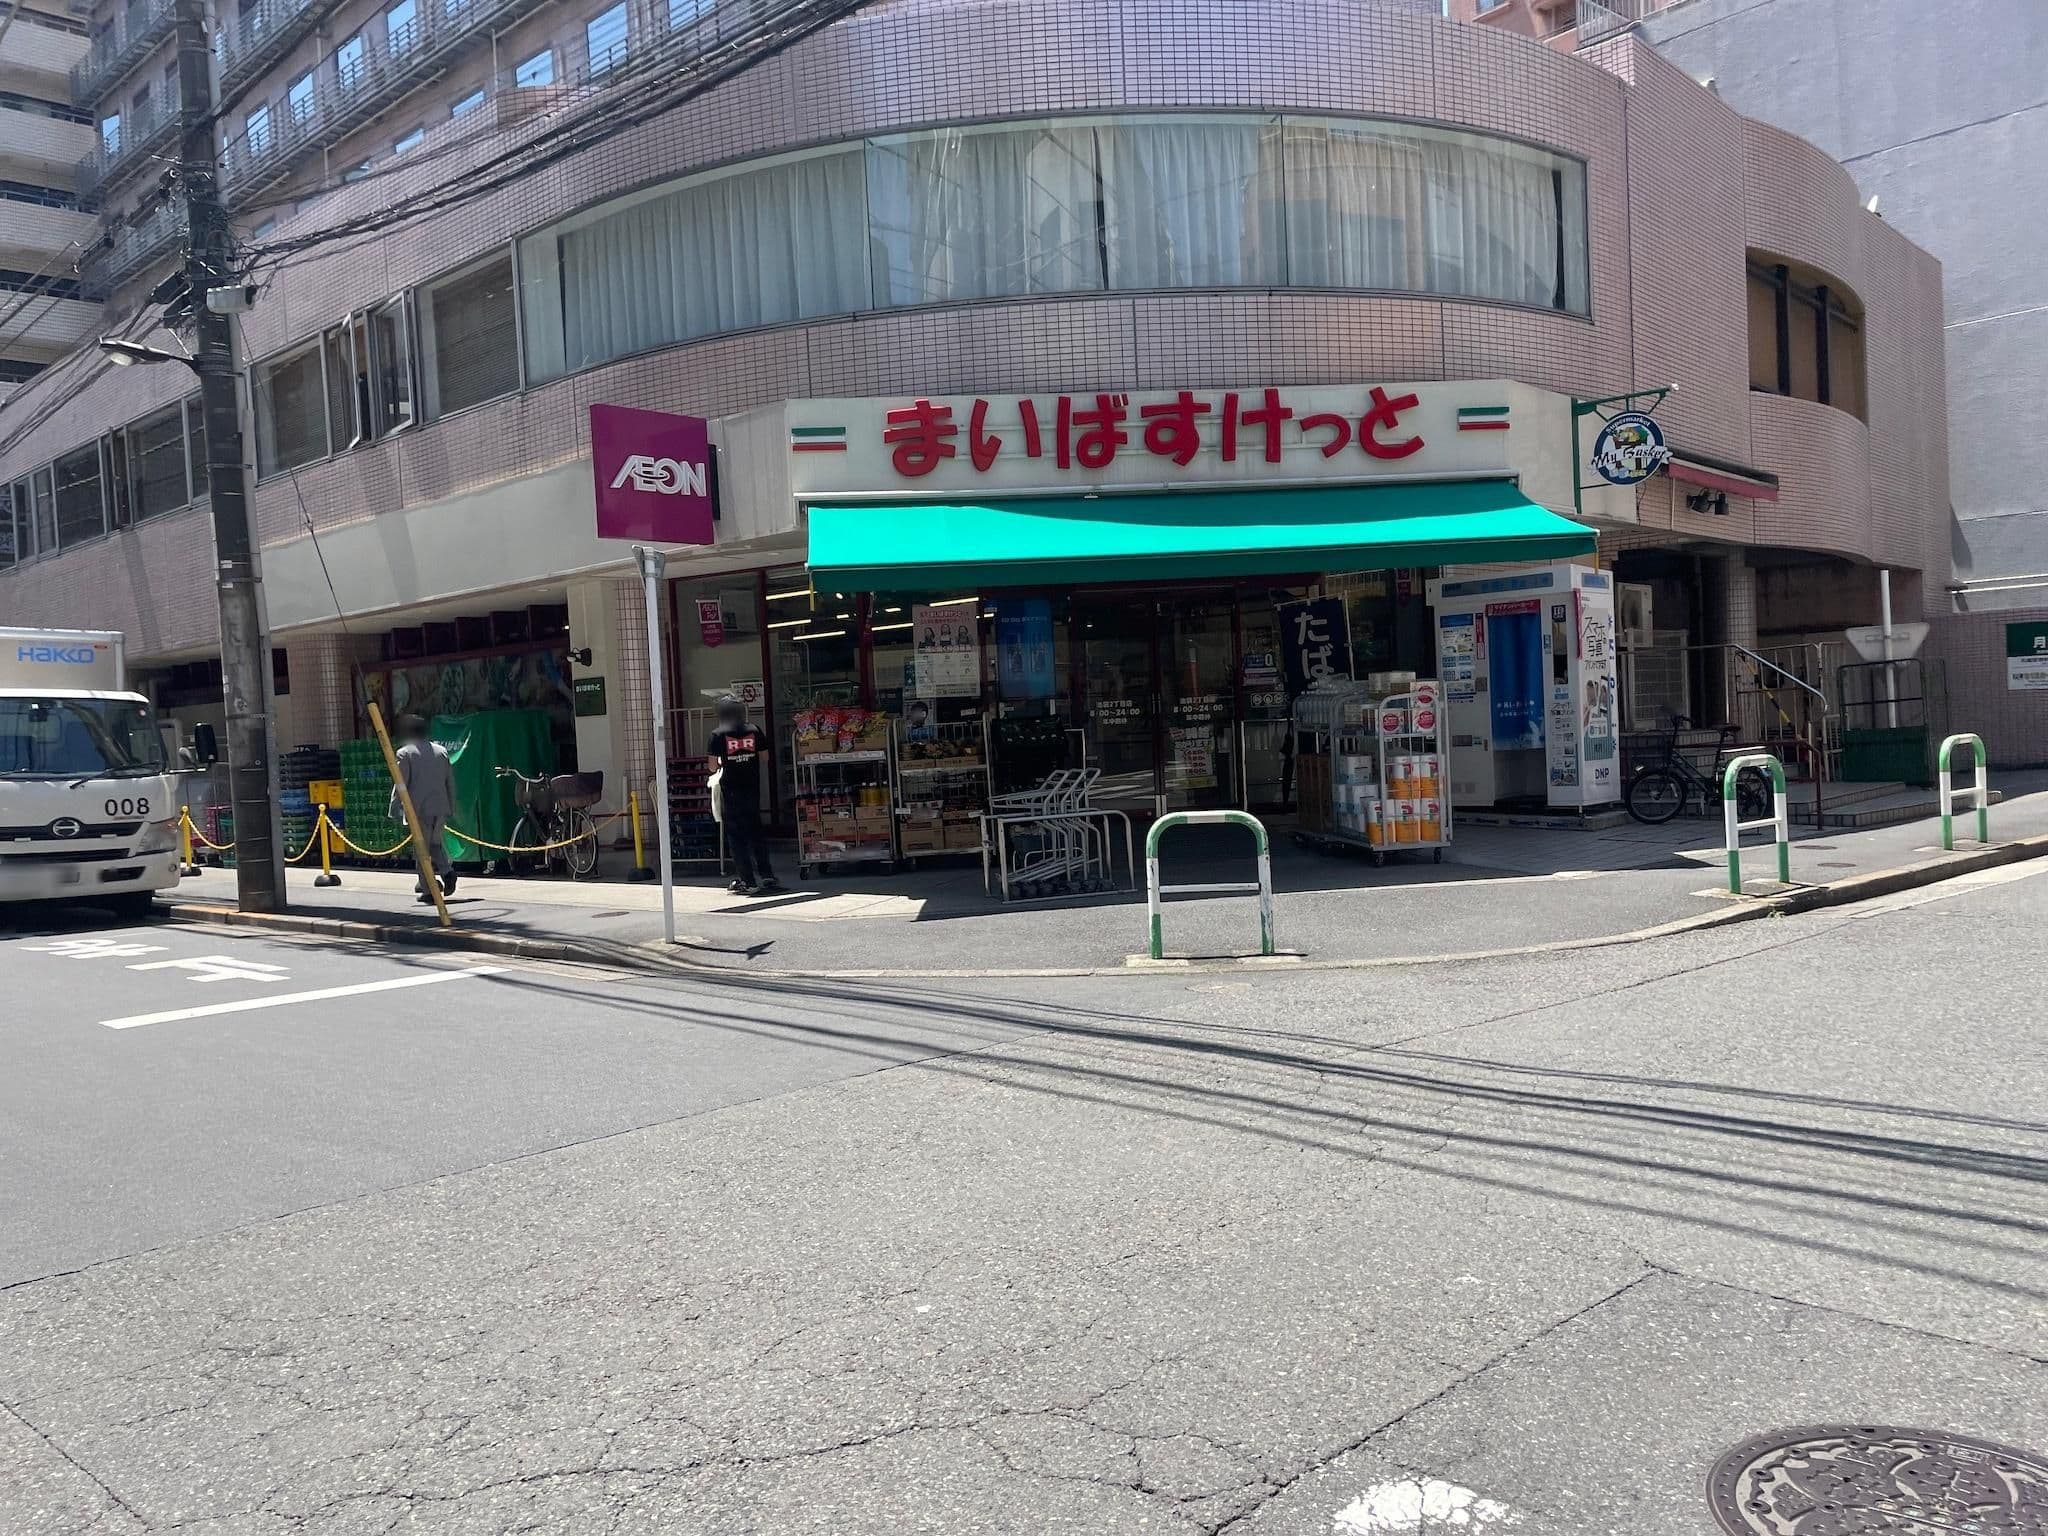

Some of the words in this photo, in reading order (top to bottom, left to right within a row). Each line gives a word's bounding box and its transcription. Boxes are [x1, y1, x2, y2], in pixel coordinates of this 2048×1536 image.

[883, 386, 1425, 477] まいばすけっと
[1605, 415, 1651, 434] Supermarket
[1591, 452, 1617, 468] My
[1622, 445, 1667, 460] Basket
[1294, 611, 1335, 690] たば
[1595, 767, 1610, 780] DNP
[105, 797, 150, 816] 008
